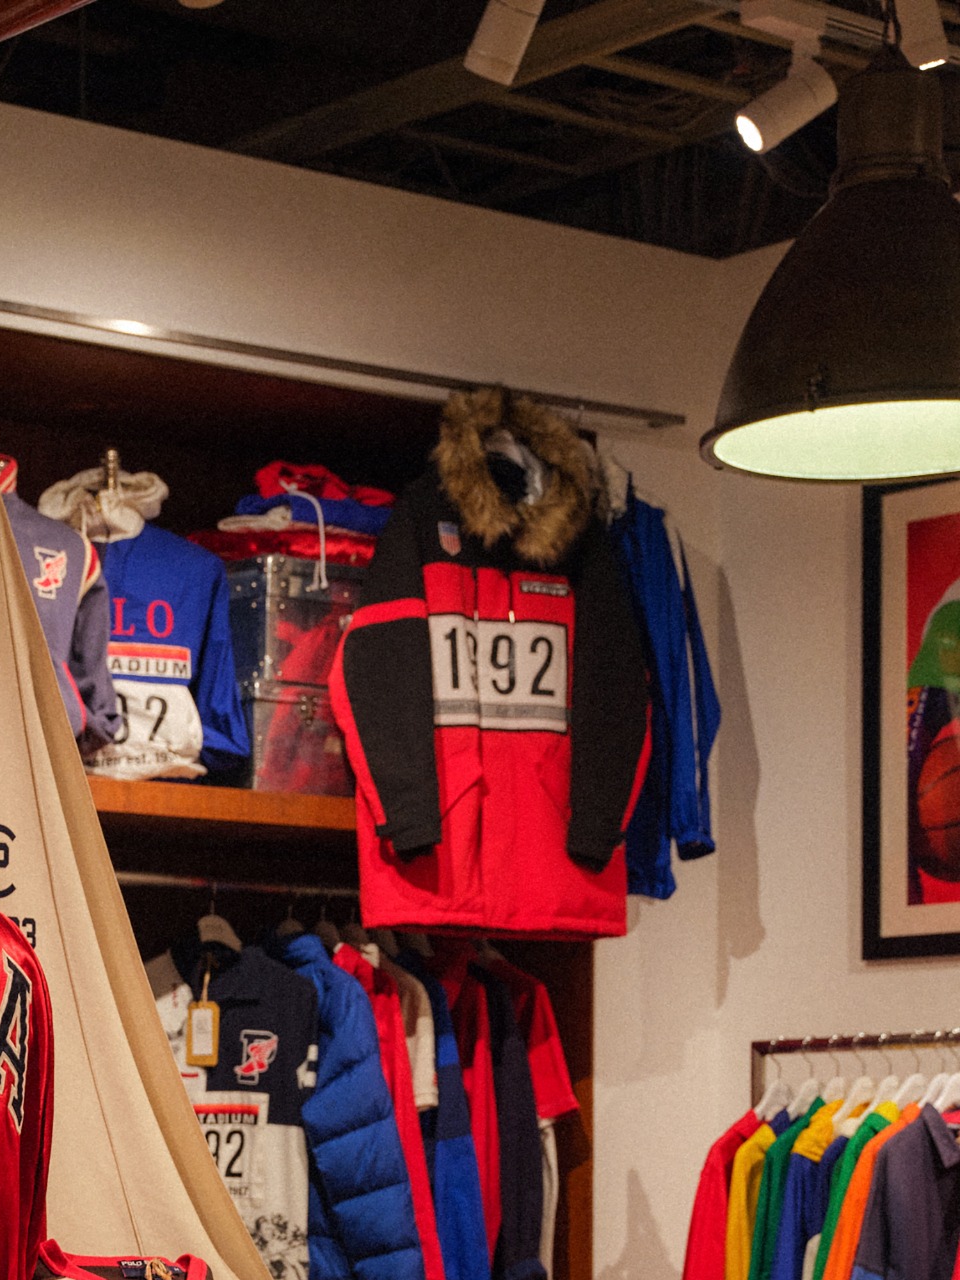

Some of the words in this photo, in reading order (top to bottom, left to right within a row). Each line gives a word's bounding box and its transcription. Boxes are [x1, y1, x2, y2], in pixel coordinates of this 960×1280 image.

[111, 598, 174, 638] LO
[111, 659, 189, 676] ADIUM
[197, 1113, 255, 1125] TADIUM
